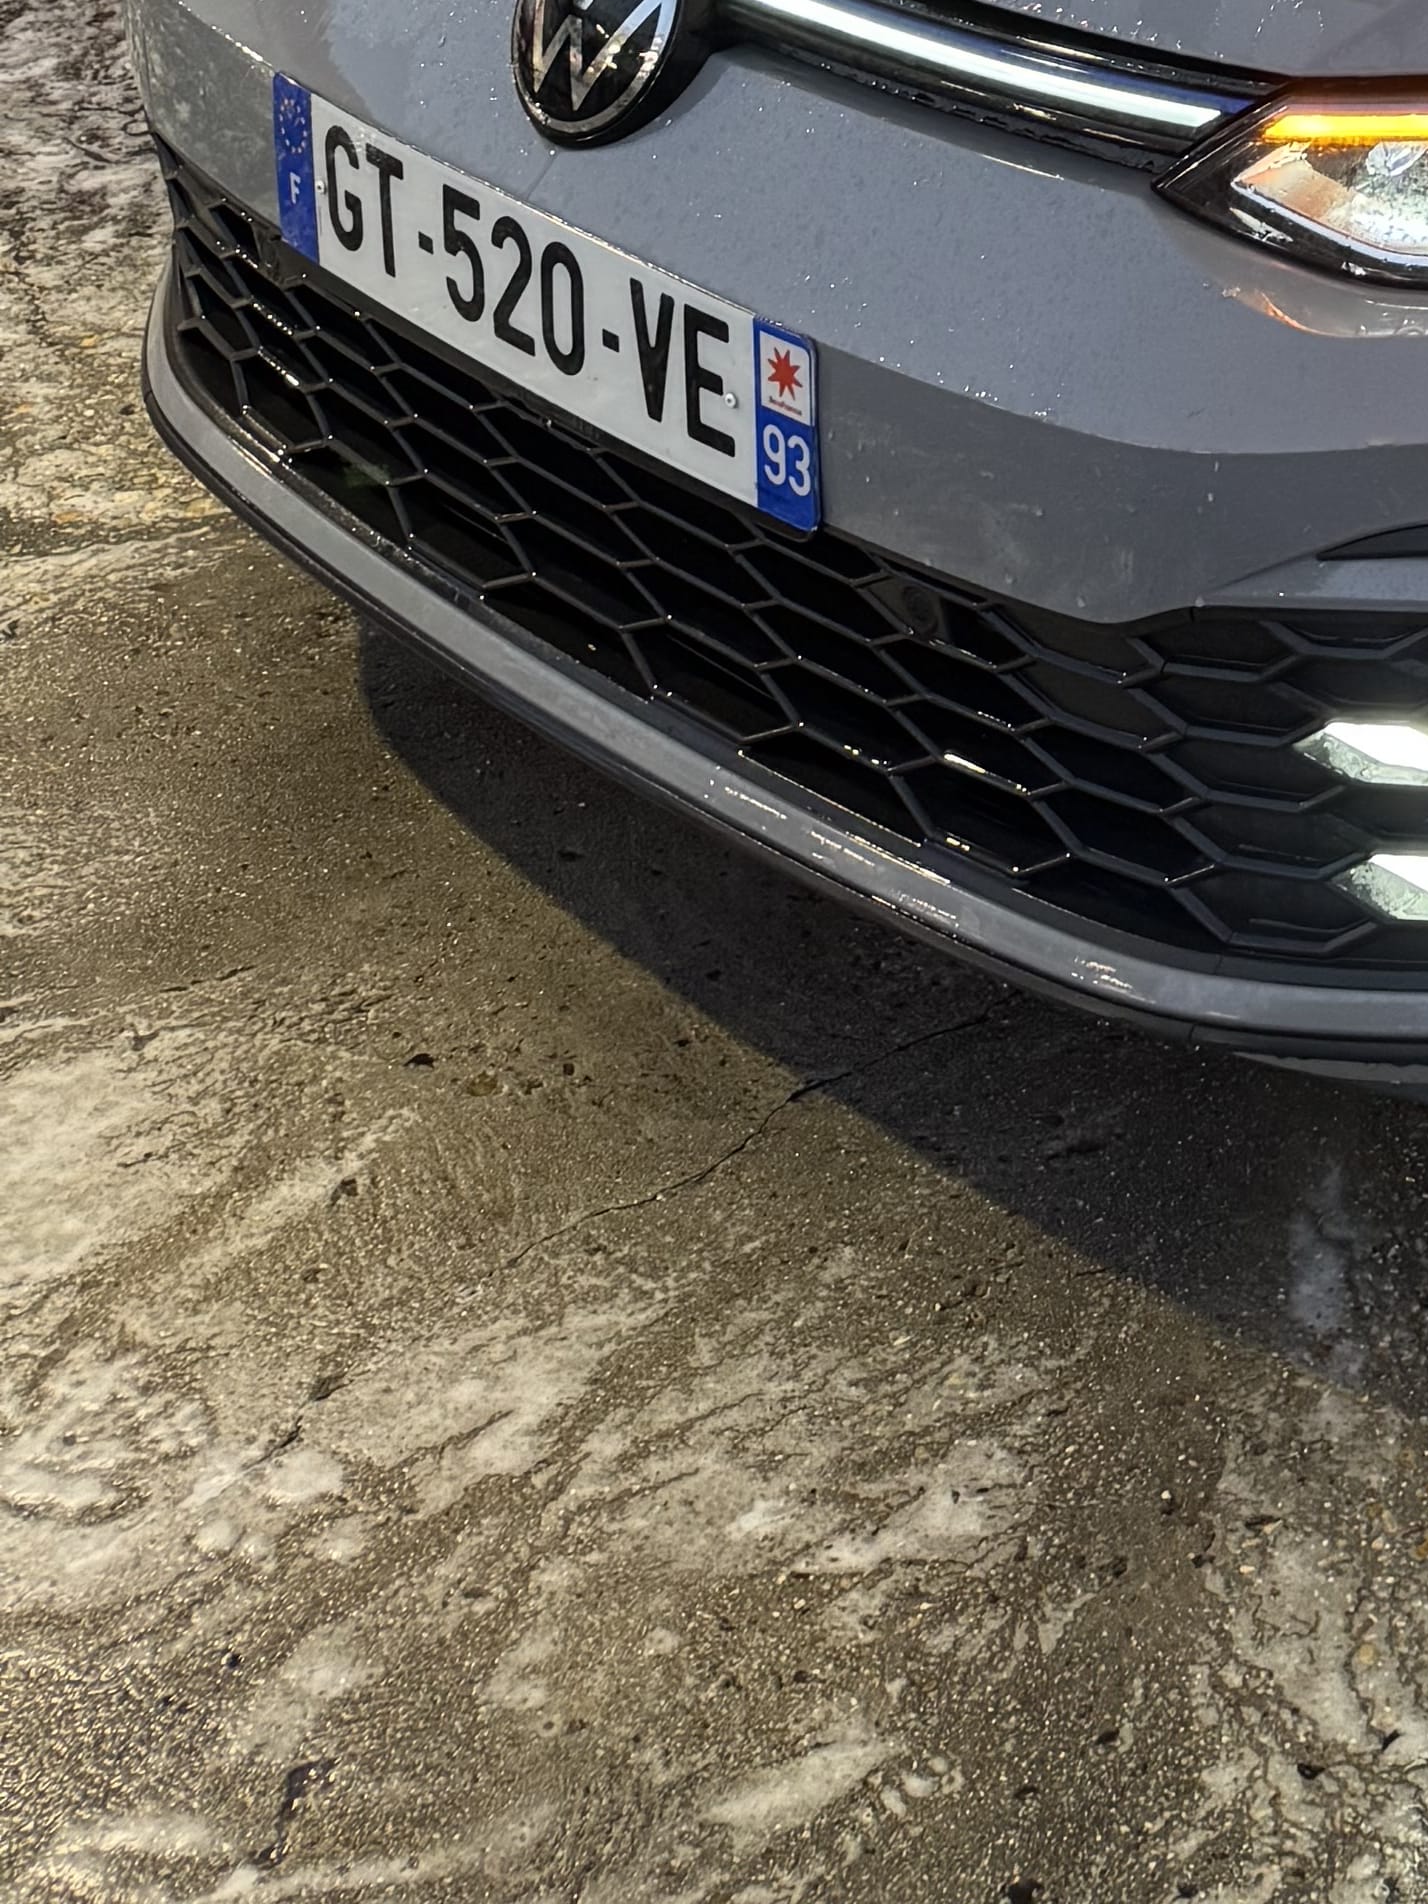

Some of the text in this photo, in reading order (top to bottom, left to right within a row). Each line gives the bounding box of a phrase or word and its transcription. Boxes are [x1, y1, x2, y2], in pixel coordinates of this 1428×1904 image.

[289, 172, 301, 204] F
[325, 124, 736, 458] GT-520-VE
[763, 424, 811, 496] 93
